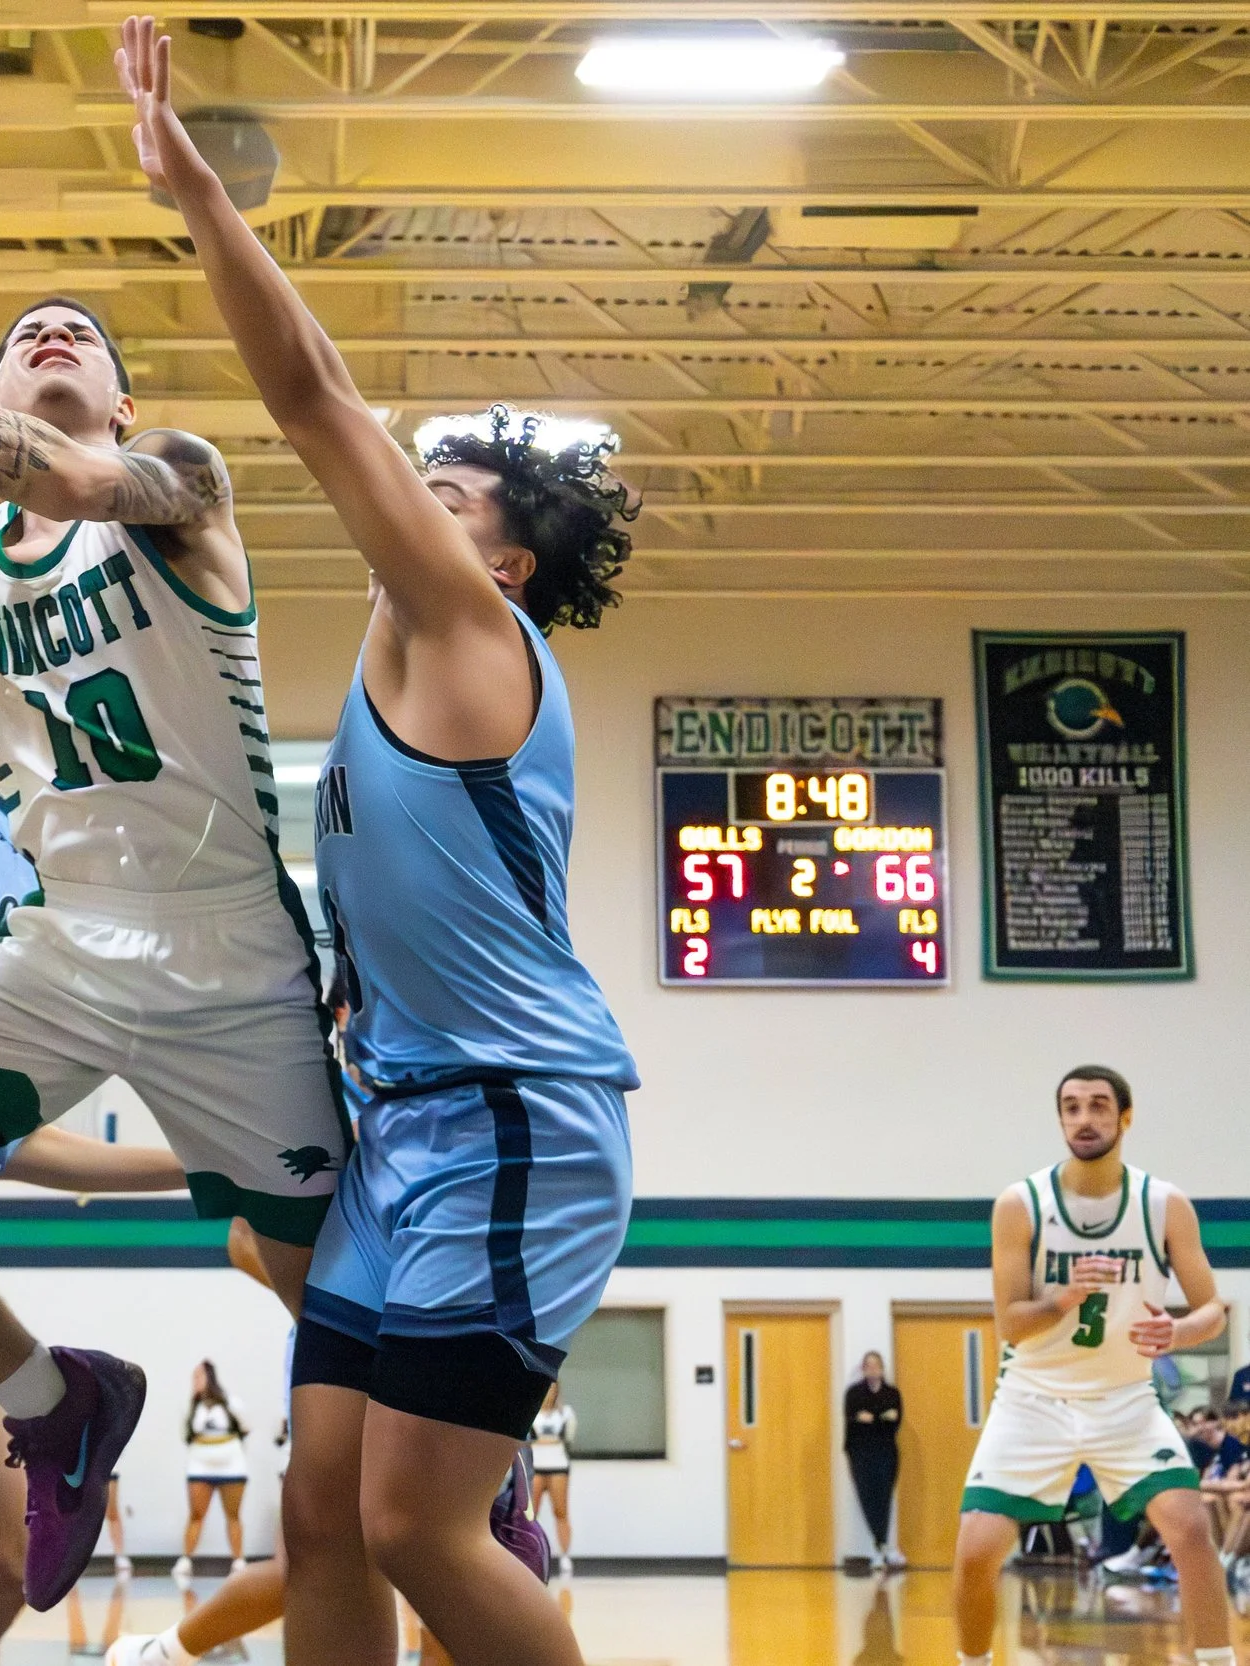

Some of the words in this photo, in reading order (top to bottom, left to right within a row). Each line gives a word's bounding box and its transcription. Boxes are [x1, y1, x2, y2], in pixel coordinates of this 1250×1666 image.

[22, 667, 163, 791] 10
[672, 708, 926, 755] ENDICOTT
[766, 773, 868, 821] 8:48
[1080, 767, 1149, 788] KILLS
[683, 853, 744, 901] 57
[791, 858, 817, 898] 2
[875, 854, 936, 902] 66
[670, 908, 710, 934] FLS
[809, 908, 859, 934] FOUL
[899, 909, 938, 934] FLS
[683, 938, 709, 976] 2
[911, 941, 937, 974] 4
[1045, 1249, 1144, 1285] ENTT
[1071, 1292, 1109, 1348] 5
